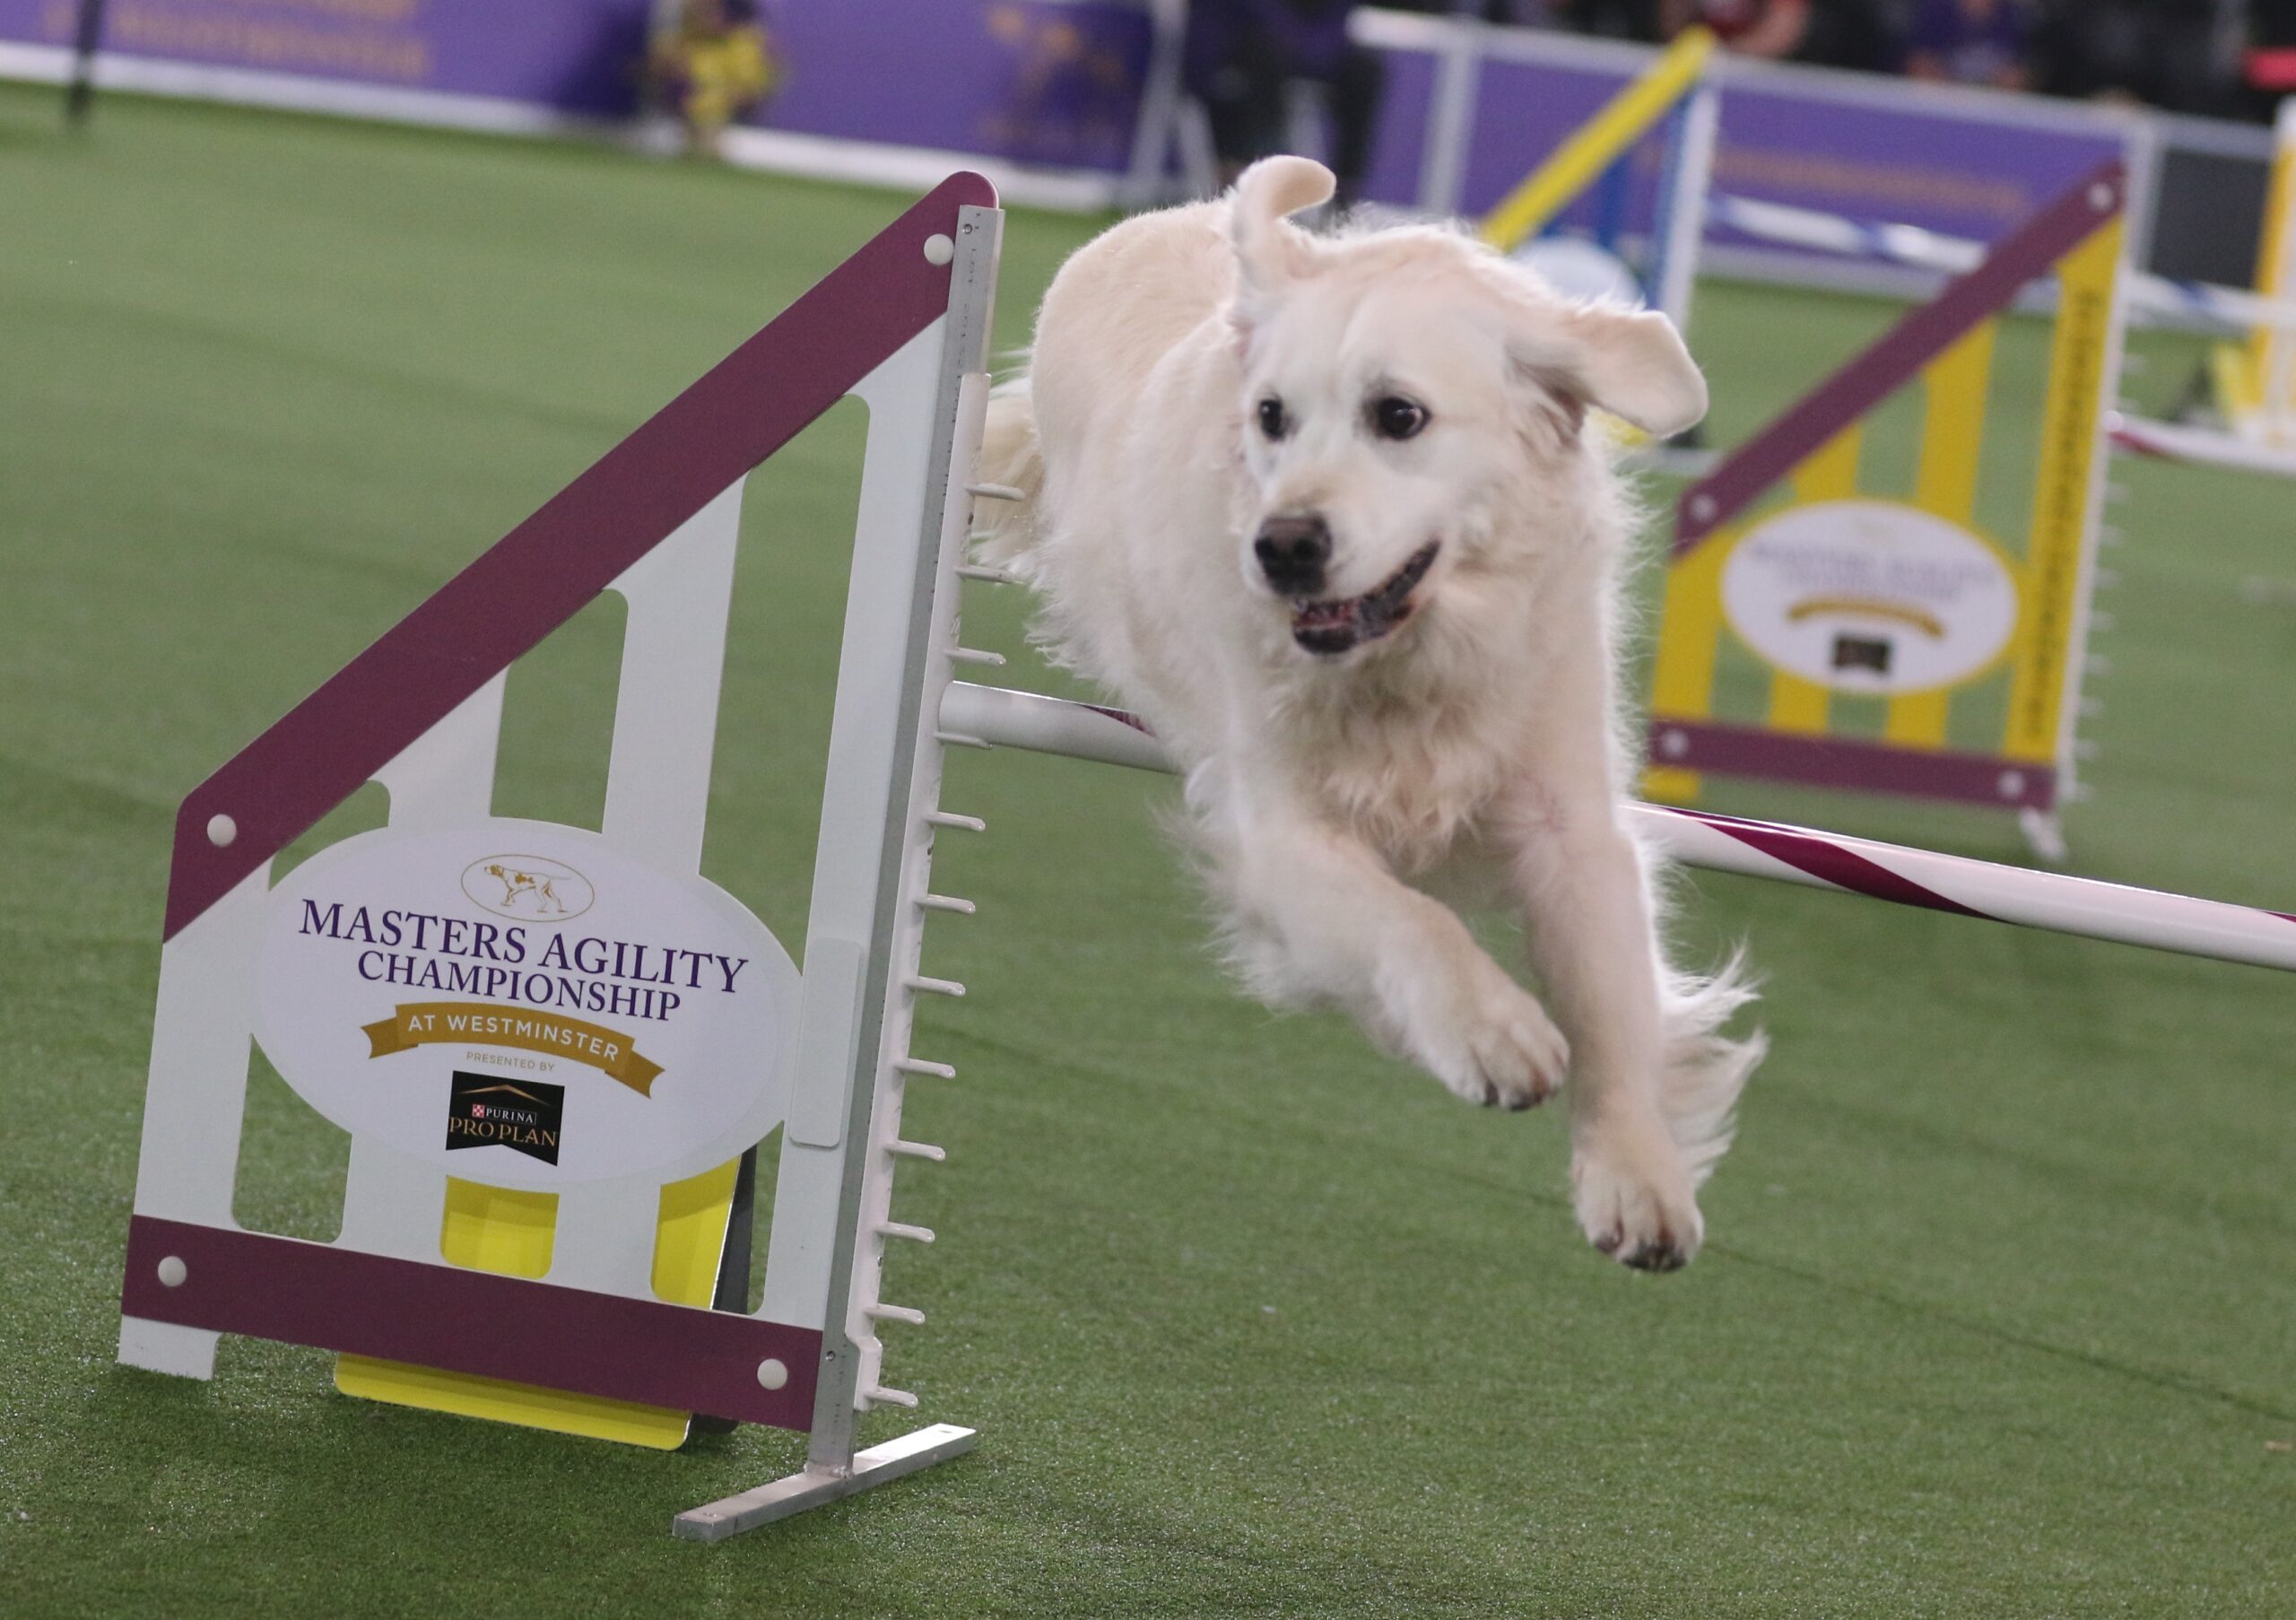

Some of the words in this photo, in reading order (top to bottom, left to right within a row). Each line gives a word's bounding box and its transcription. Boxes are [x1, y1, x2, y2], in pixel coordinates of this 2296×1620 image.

[299, 899, 527, 964] MASTERS
[541, 932, 750, 994] AGILITY
[358, 950, 682, 1022] CHAMPIONSHIP
[408, 1014, 436, 1032] AT
[448, 1015, 619, 1062] WESTMINSTER
[465, 1050, 535, 1070] PRESENTED
[539, 1061, 556, 1073] BY
[448, 1117, 494, 1138] PRO
[499, 1124, 558, 1148] PLAN
[485, 1107, 535, 1125] PURINA
